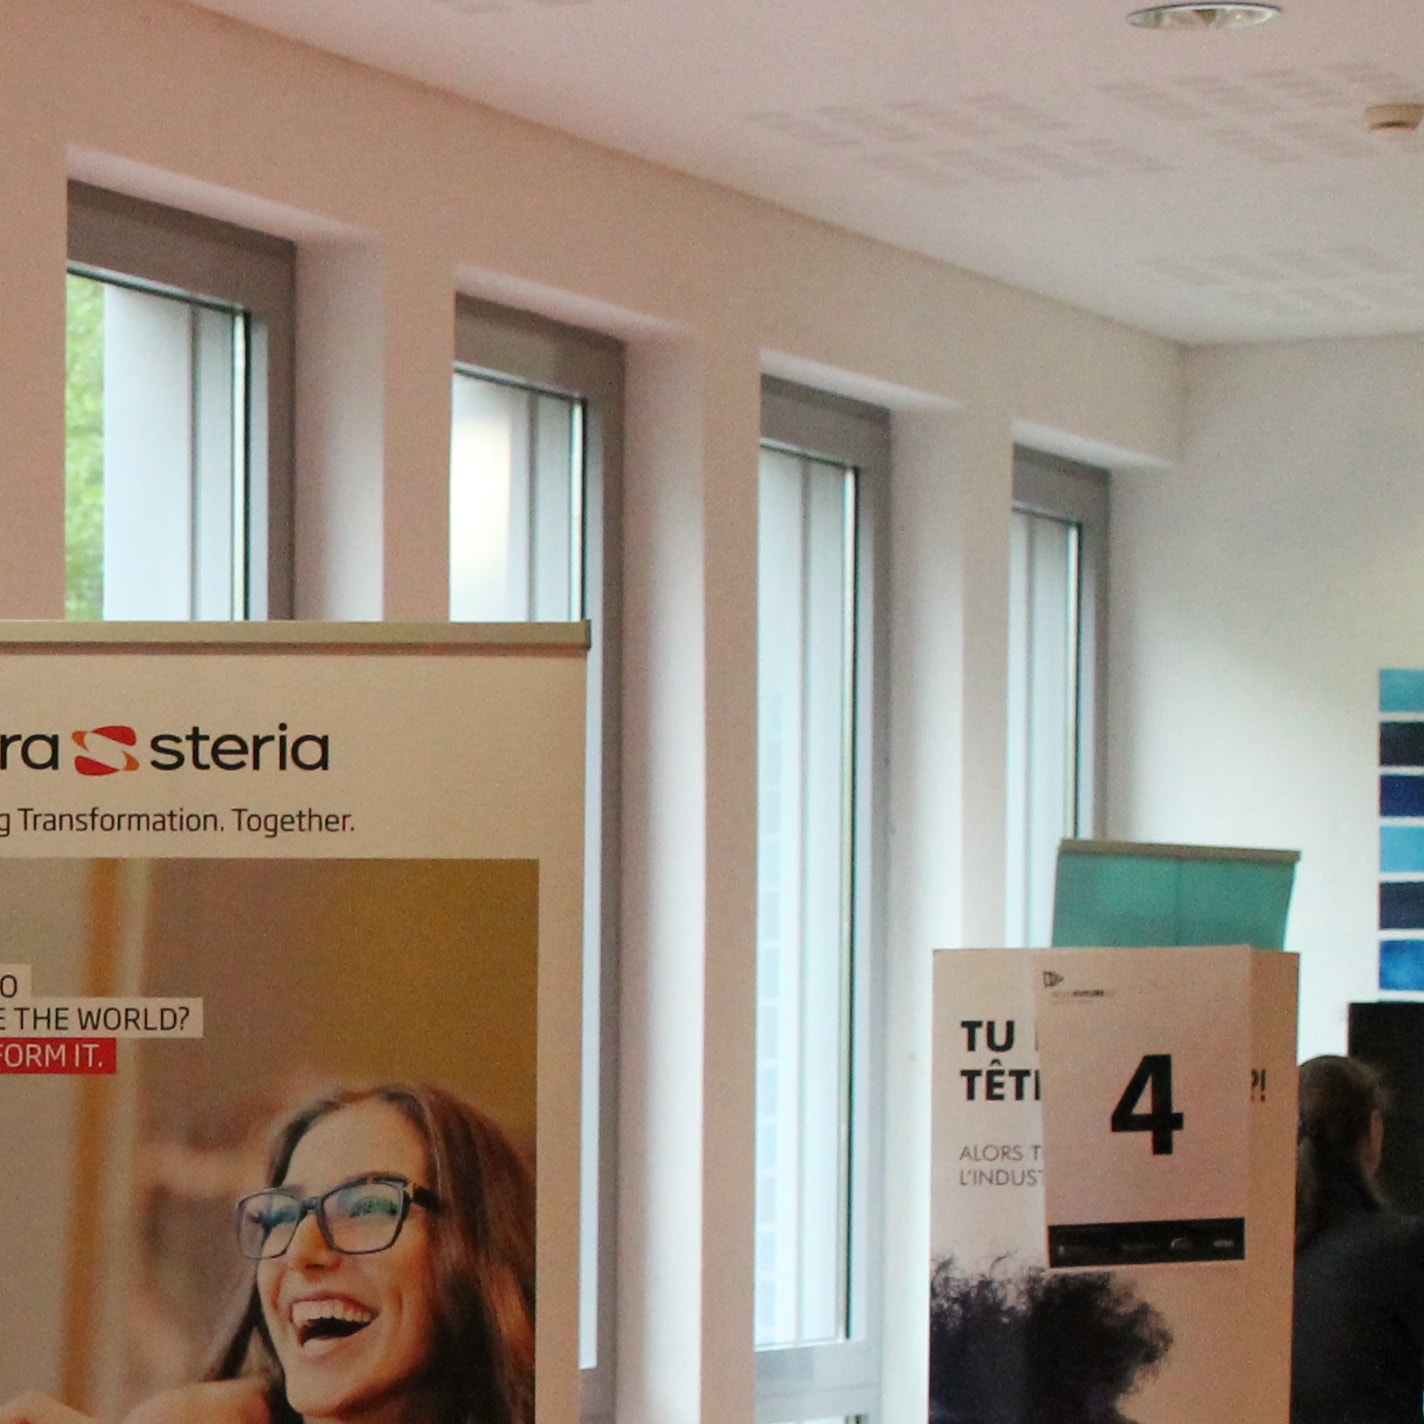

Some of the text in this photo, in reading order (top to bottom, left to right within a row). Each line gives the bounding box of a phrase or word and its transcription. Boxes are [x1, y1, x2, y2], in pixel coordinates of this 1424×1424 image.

[150, 722, 330, 772] steria
[18, 806, 225, 834] Transformation.
[232, 806, 356, 838] Together.
[14, 1006, 70, 1032] THE
[77, 1006, 191, 1032] WORLD?
[960, 1020, 1015, 1053] TU
[74, 1043, 104, 1069] IT.
[1110, 1053, 1185, 1156] 4
[959, 1143, 1024, 1163] ALORS
